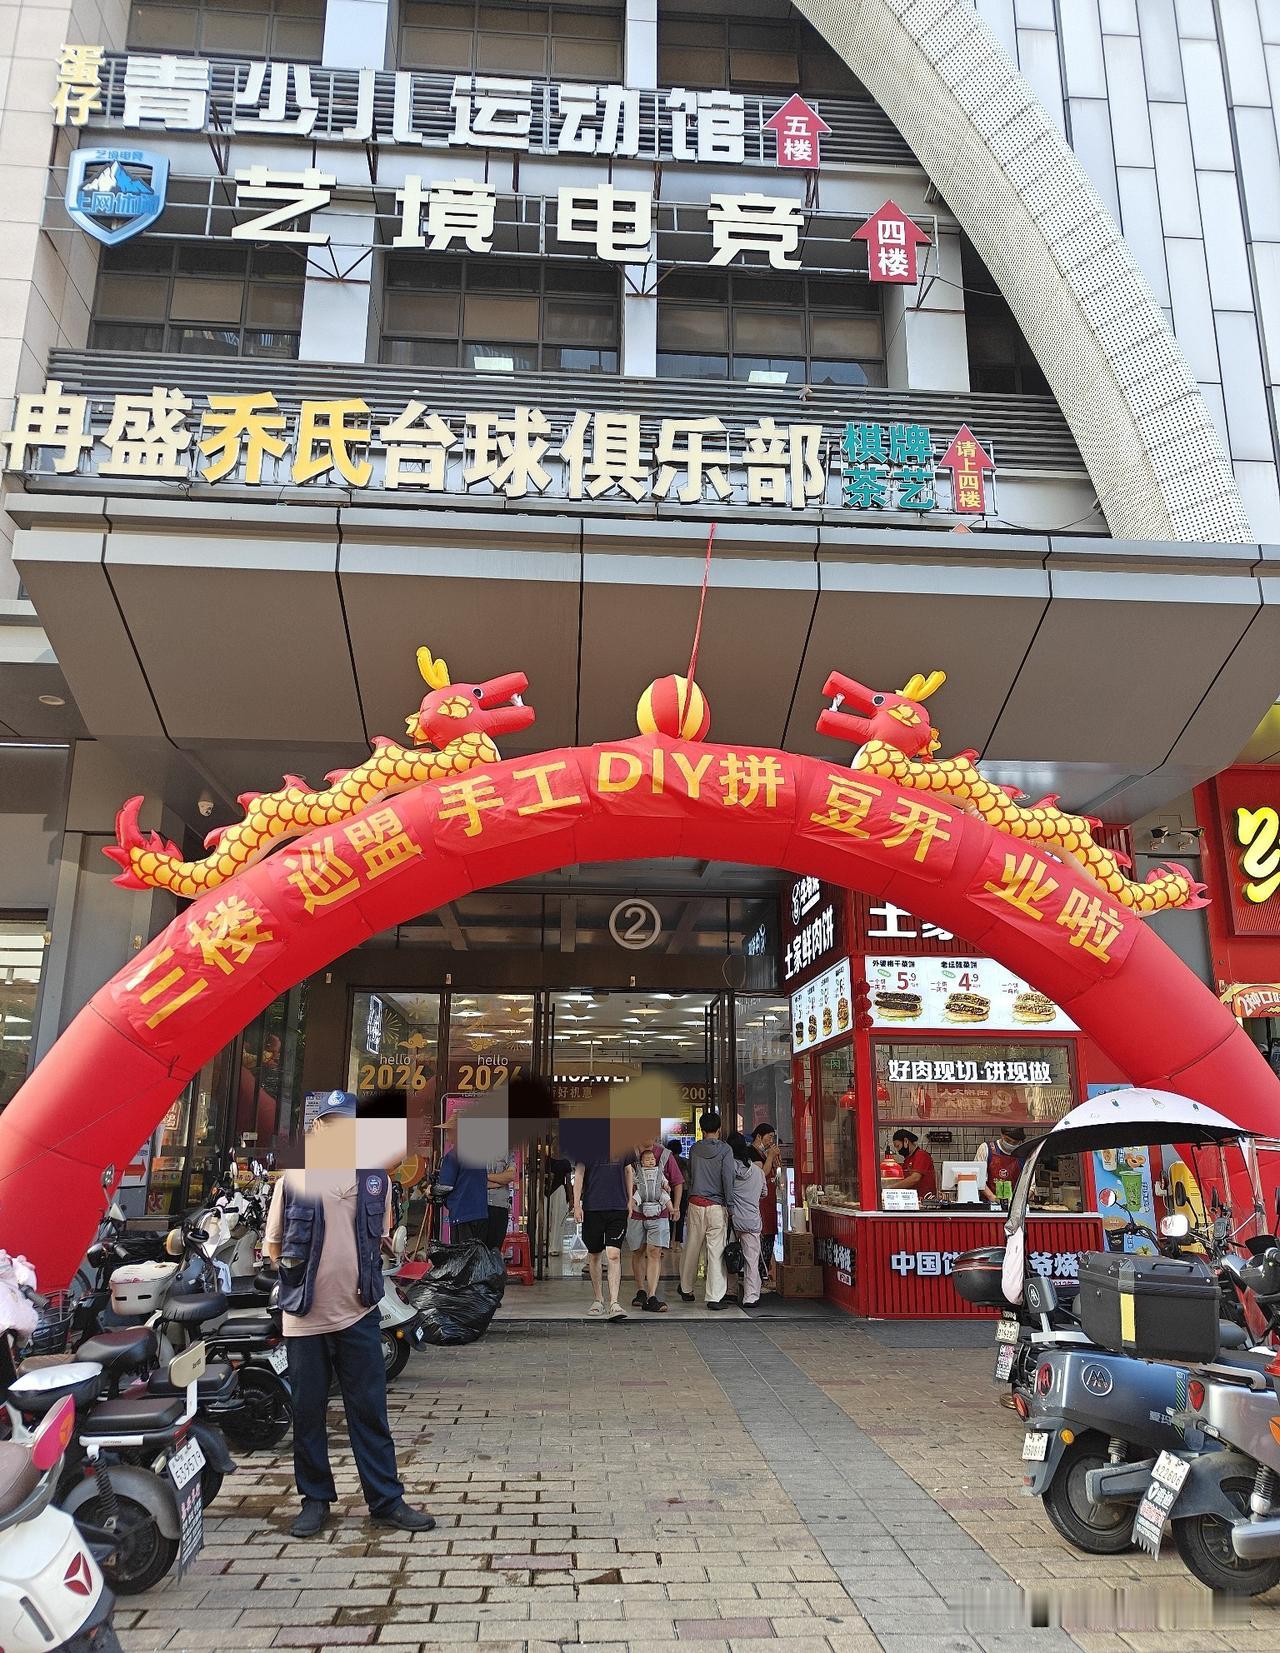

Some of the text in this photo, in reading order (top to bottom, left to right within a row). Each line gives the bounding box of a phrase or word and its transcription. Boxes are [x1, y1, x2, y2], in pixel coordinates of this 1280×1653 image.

[51, 43, 106, 127] 蛋仔
[121, 55, 746, 165] 青少儿运动馆
[783, 115, 813, 162] 五楼
[231, 166, 805, 271] 艺境电竞
[876, 219, 910, 278] 四楼
[1, 380, 827, 510] 冉盛乔氏台球俱乐部
[841, 421, 931, 465] 棋牌
[842, 465, 936, 511] 茶艺
[955, 439, 981, 509] 请上四楼
[784, 904, 834, 980] 土家鲜肉饼
[896, 971, 917, 991] 5.9
[958, 972, 979, 991] 4.9
[360, 1064, 427, 1090] 2026
[379, 1053, 411, 1065] hello
[477, 1055, 509, 1066] hello
